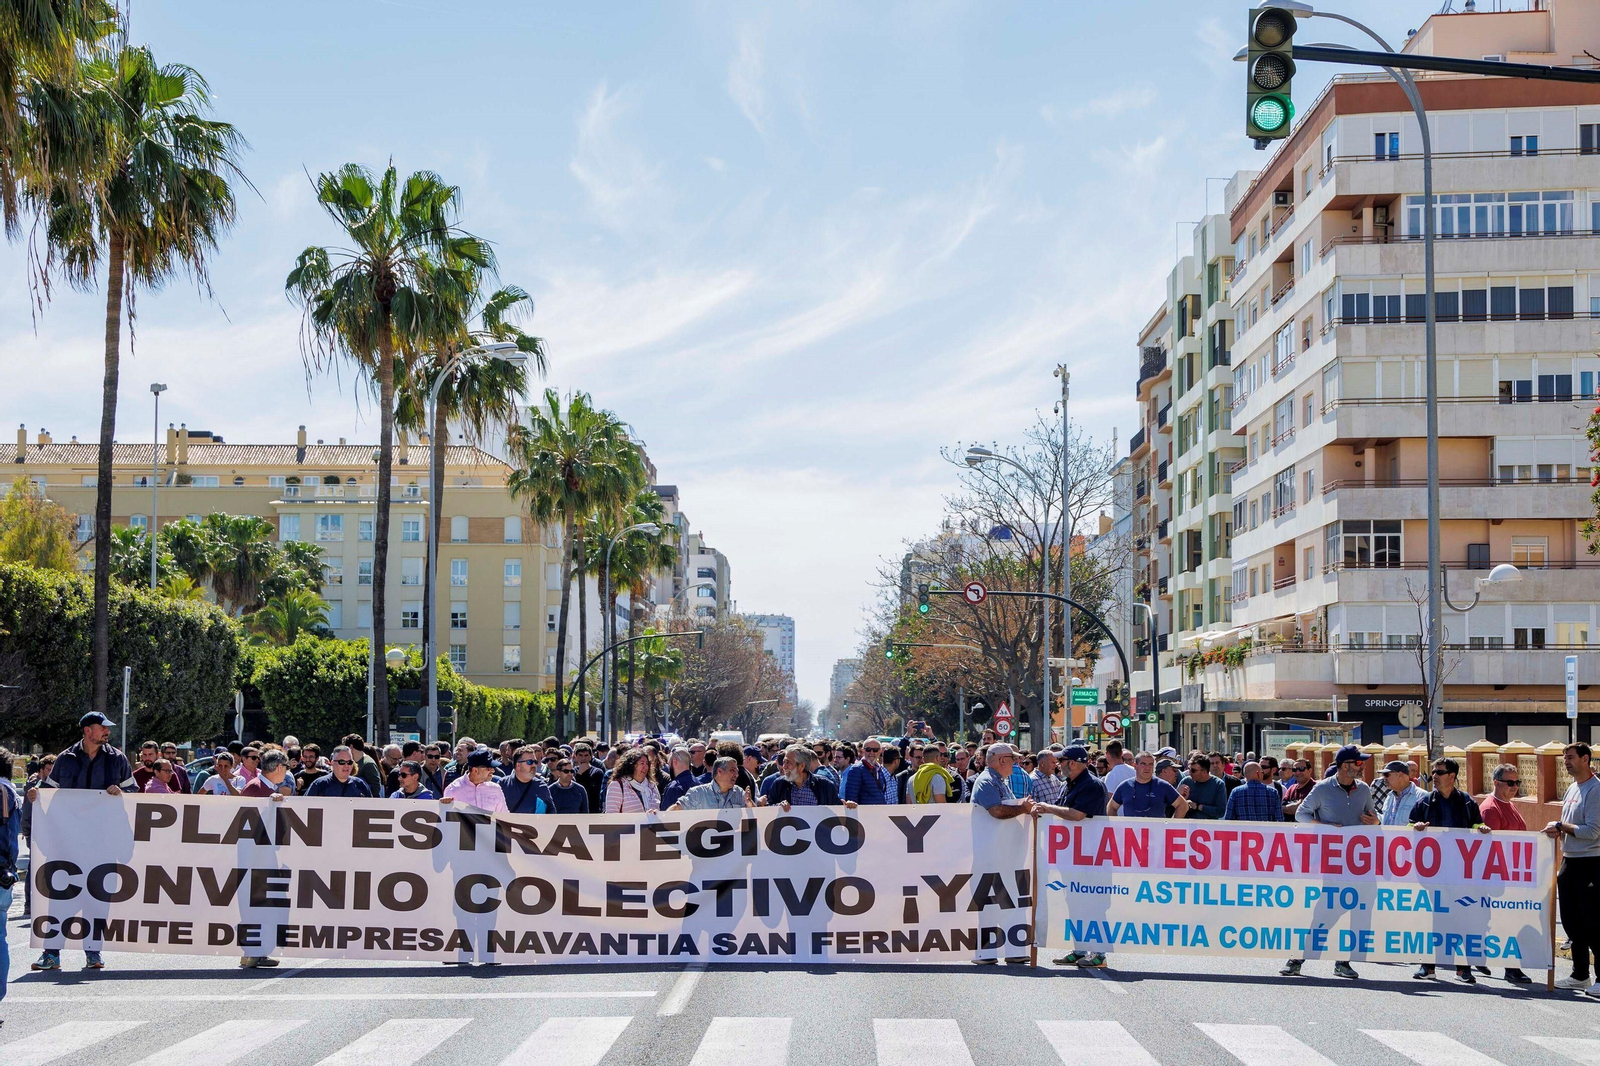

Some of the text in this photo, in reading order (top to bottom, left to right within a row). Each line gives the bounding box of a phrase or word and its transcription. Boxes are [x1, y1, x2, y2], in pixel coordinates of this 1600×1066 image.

[1364, 699, 1424, 707] SPRINGFIELD
[998, 723, 1009, 731] 50
[133, 802, 942, 862] PLAN ESTRATEGICO Y
[1048, 824, 1534, 883] PLAN ESTRATEGICO YA!!
[34, 860, 1034, 925] CONVENIO COLECTIVO ¡YA!
[1070, 880, 1130, 896] Navantia
[1135, 880, 1450, 914] ASTILLERO PTO. REAL
[1480, 896, 1543, 912] Navantia
[32, 915, 1033, 957] COMITE DE EMPRESA NAVANTIA SAN FERNANDO
[1064, 918, 1524, 960] NAVANTIA COMITÉ DE EMPRESA
